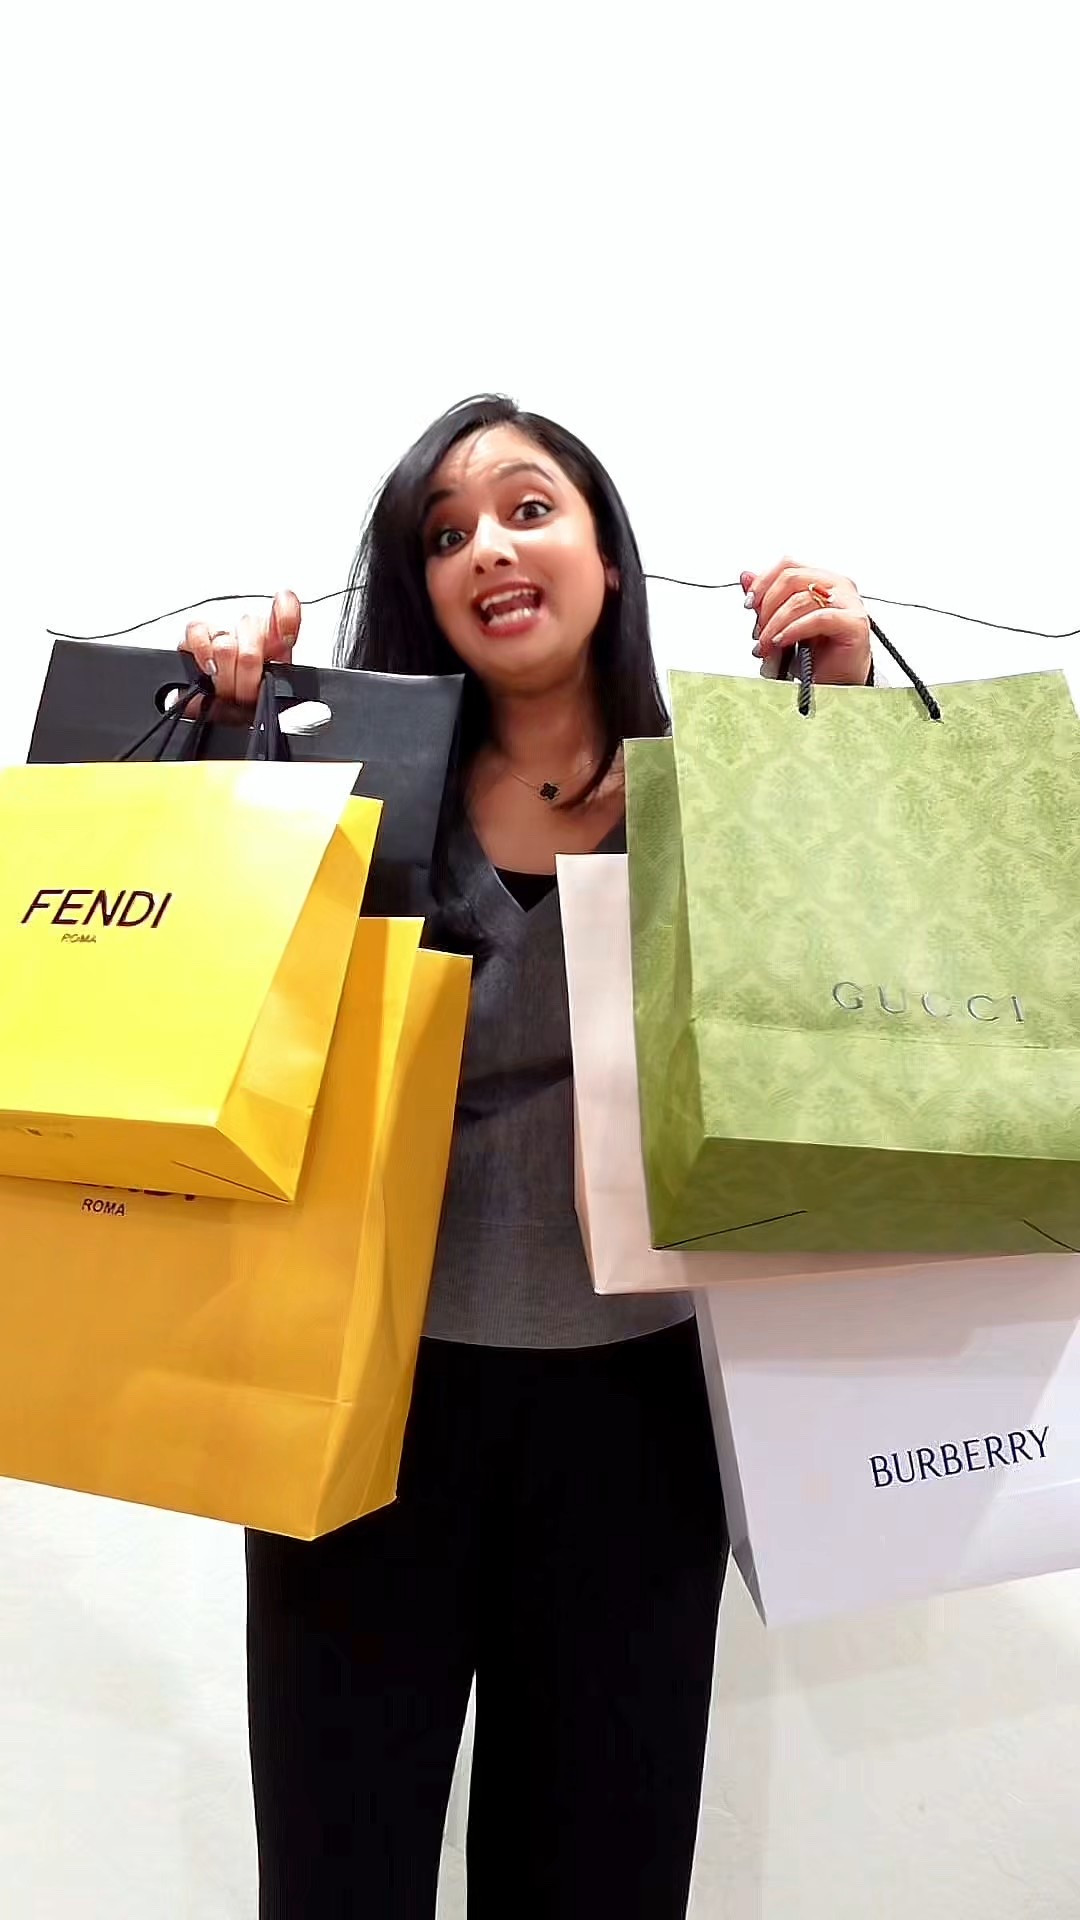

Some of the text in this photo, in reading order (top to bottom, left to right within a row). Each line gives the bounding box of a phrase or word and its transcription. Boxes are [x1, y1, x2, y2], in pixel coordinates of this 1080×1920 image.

[20, 889, 173, 929] FENDI
[60, 933, 97, 944] ROMA
[832, 981, 1025, 1022] GUCCI
[81, 1198, 126, 1217] ROMA
[869, 1425, 1050, 1488] BURBERRY
